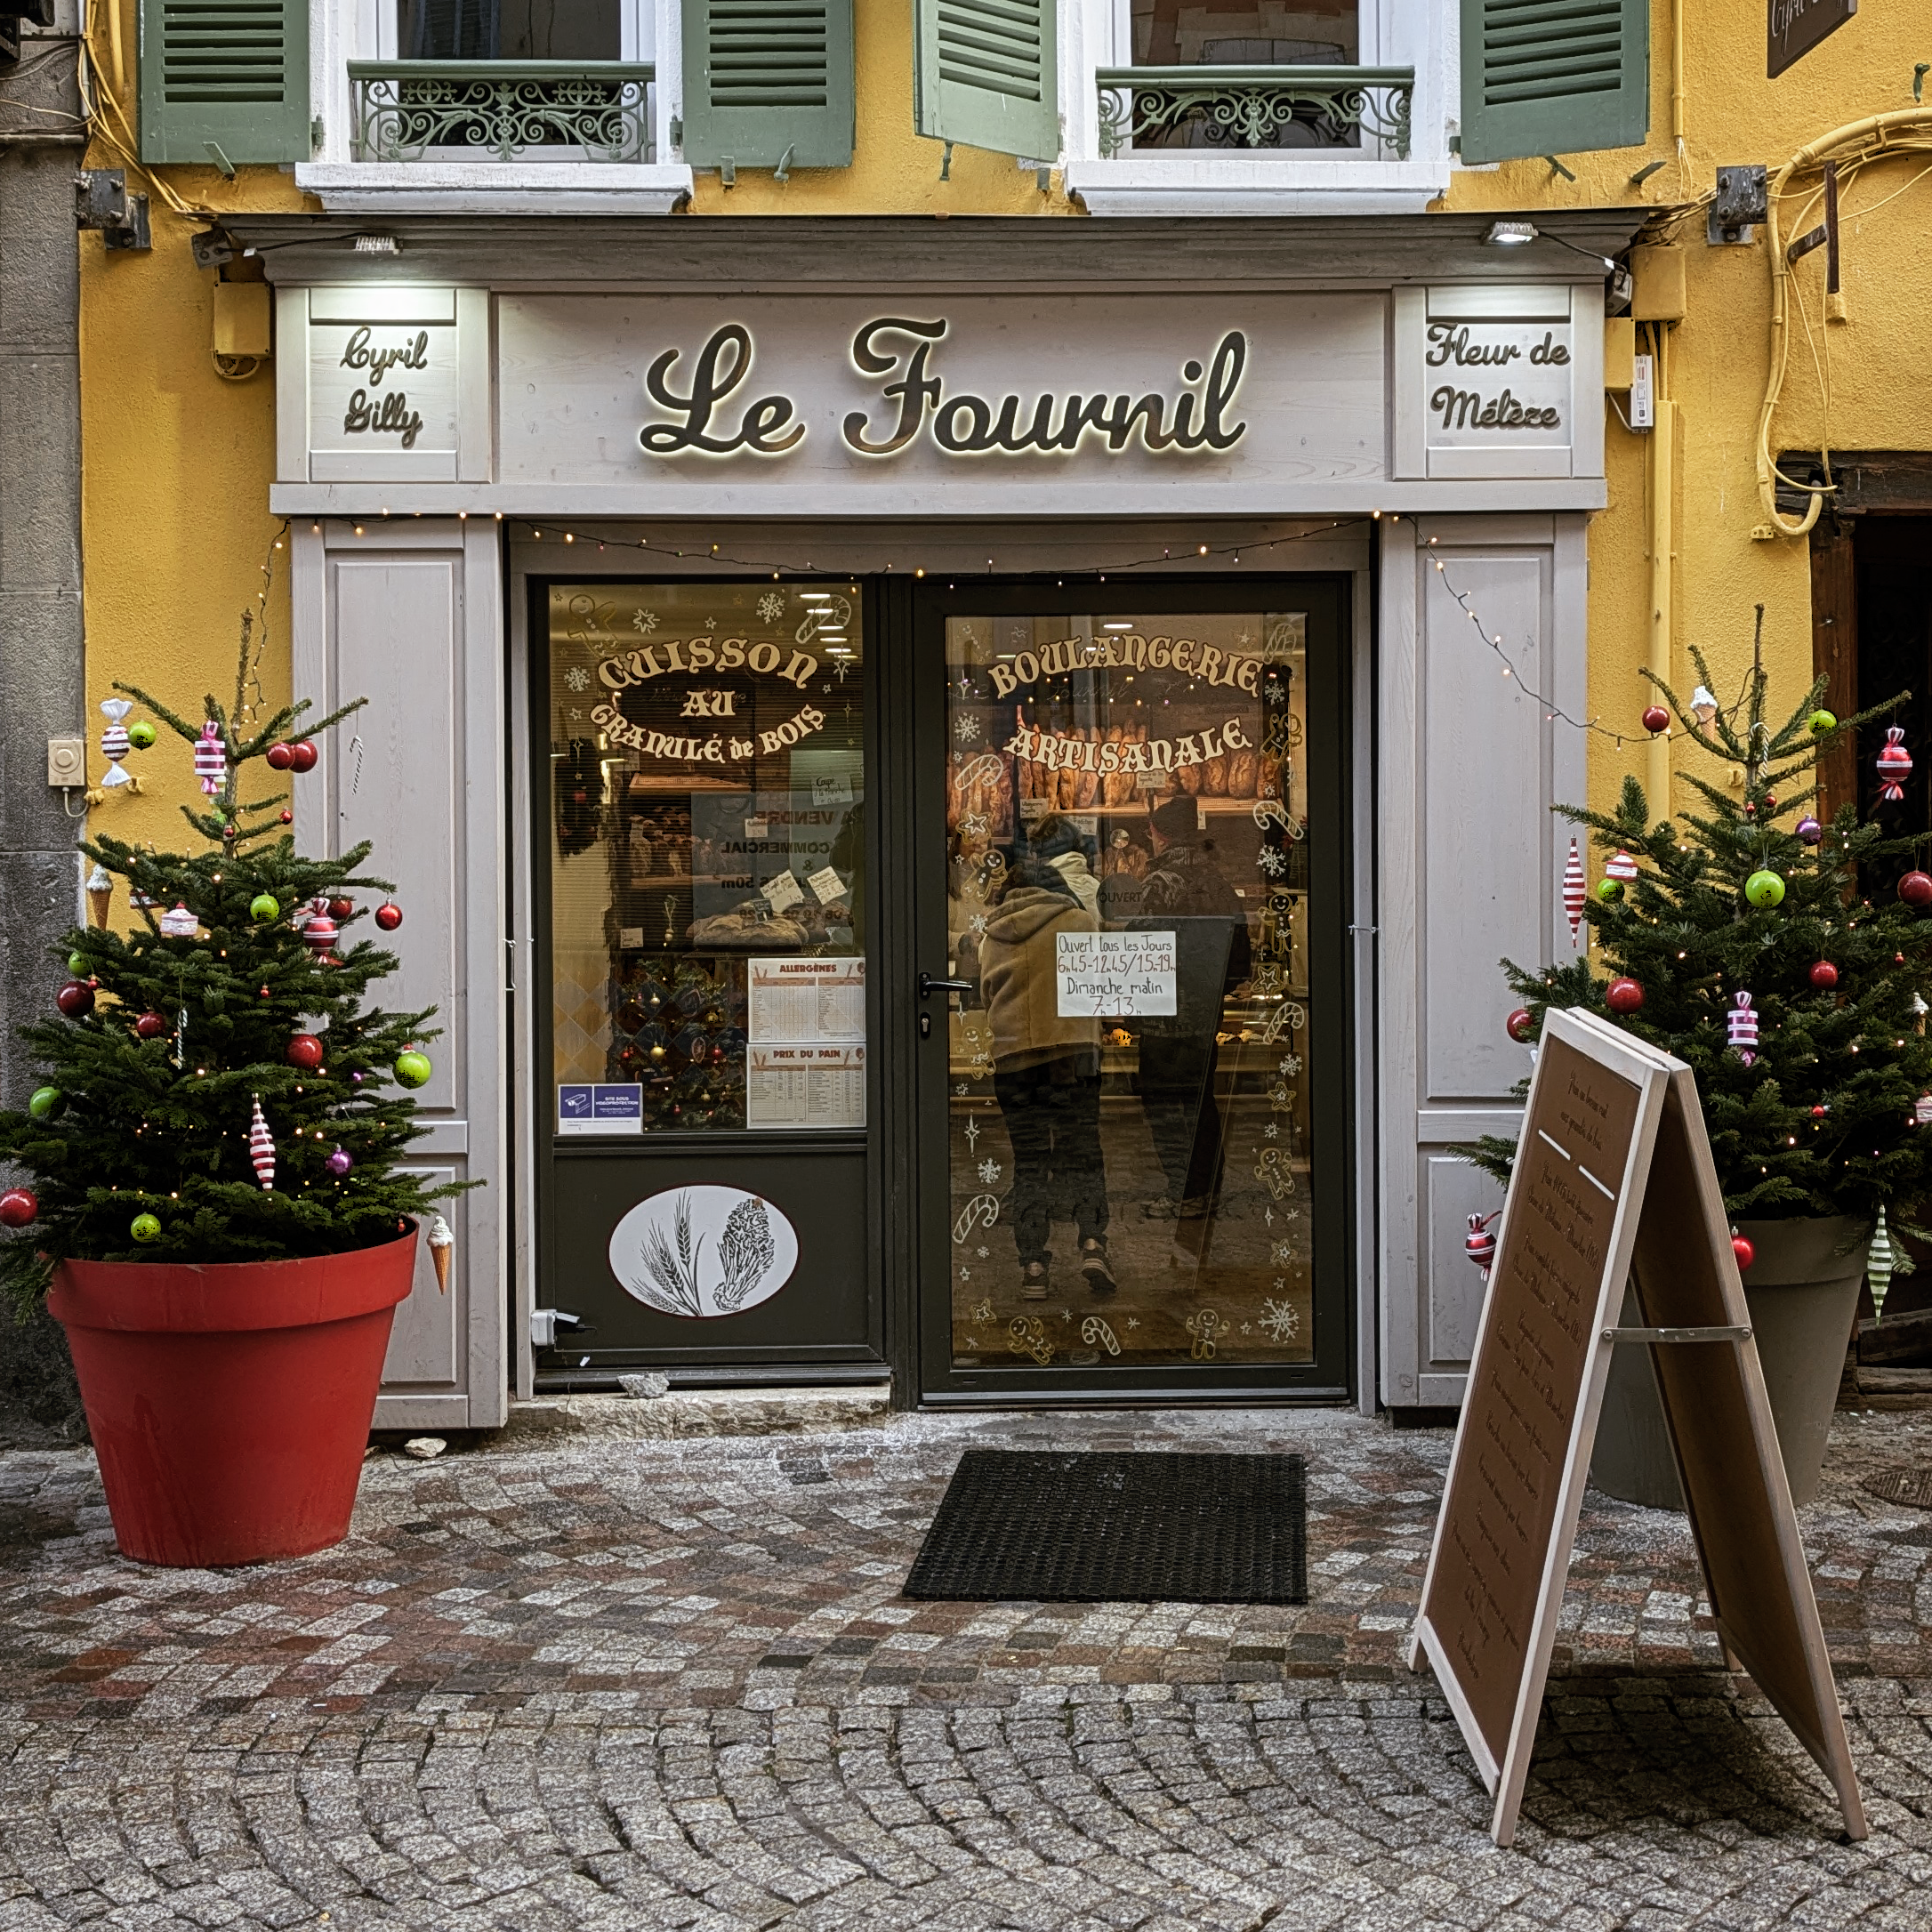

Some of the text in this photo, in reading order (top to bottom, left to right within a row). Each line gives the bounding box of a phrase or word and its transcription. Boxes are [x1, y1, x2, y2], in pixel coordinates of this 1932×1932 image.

[340, 326, 428, 386] Cyril
[1426, 322, 1570, 366] Fleur de
[639, 318, 1247, 455] Le Fournil
[1431, 385, 1560, 430] Mélèze
[344, 390, 423, 448] Gilly
[598, 635, 818, 689] CUISSON
[988, 633, 1264, 698] BOULANGERIE
[680, 690, 737, 718] AU
[590, 704, 826, 764] GRANULÉ de BOIS
[1002, 717, 1253, 777] ARTISANALE
[1099, 891, 1142, 903] OUVERT
[1059, 934, 1171, 953] Ouvert tous les Jours
[779, 962, 837, 973] ALLERGÈNES
[1067, 977, 1163, 994] Dimanche matin
[773, 1050, 841, 1059] PRIX DU PAIN
